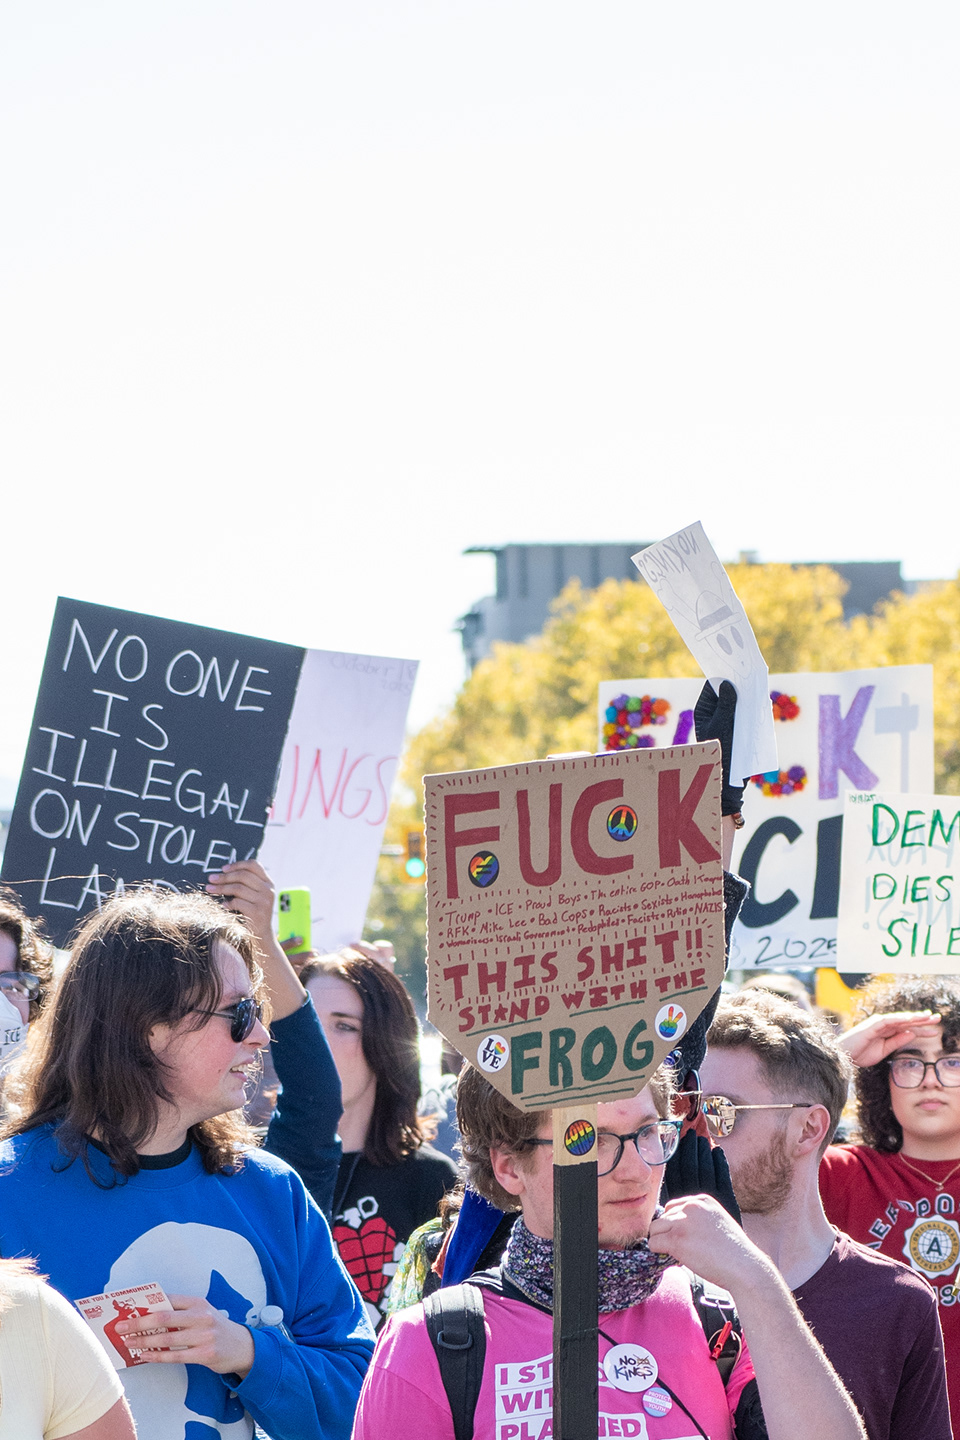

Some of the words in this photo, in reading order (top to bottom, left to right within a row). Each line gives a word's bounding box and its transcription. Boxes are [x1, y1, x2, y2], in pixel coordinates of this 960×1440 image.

[62, 618, 148, 683] NO
[166, 649, 272, 712] ONE
[90, 689, 169, 751] IS
[32, 727, 263, 827] ILLEGAL
[268, 745, 399, 826] INGS
[30, 788, 101, 846] ON
[444, 763, 721, 899] FUCK
[445, 910, 481, 927] Trump
[495, 902, 514, 916] ICE
[525, 895, 552, 911] Proud
[558, 893, 581, 907] Boys
[610, 885, 638, 898] entire
[640, 881, 661, 892] GOP
[667, 873, 690, 887] Oath
[447, 925, 469, 938] RFK
[480, 921, 504, 934] Mike
[509, 918, 527, 929] Lee
[538, 911, 557, 926] Bad
[561, 909, 587, 925] Cops
[598, 903, 631, 917] Racists
[641, 894, 673, 911] Sexists
[694, 901, 722, 916] NAZIS
[873, 873, 954, 904] DIES
[443, 951, 560, 1001] THIS
[576, 928, 704, 983] SHIT!!
[458, 995, 551, 1033] STAND
[561, 978, 649, 1011] WITH
[654, 967, 707, 994] THE
[511, 1019, 655, 1096] FROG
[926, 1236, 942, 1256] A
[92, 1295, 104, 1303] YOU
[110, 1283, 157, 1298] COMMUNIST?
[500, 1368, 508, 1385] I
[619, 1355, 636, 1366] NO
[648, 1402, 667, 1413] YOUTH
